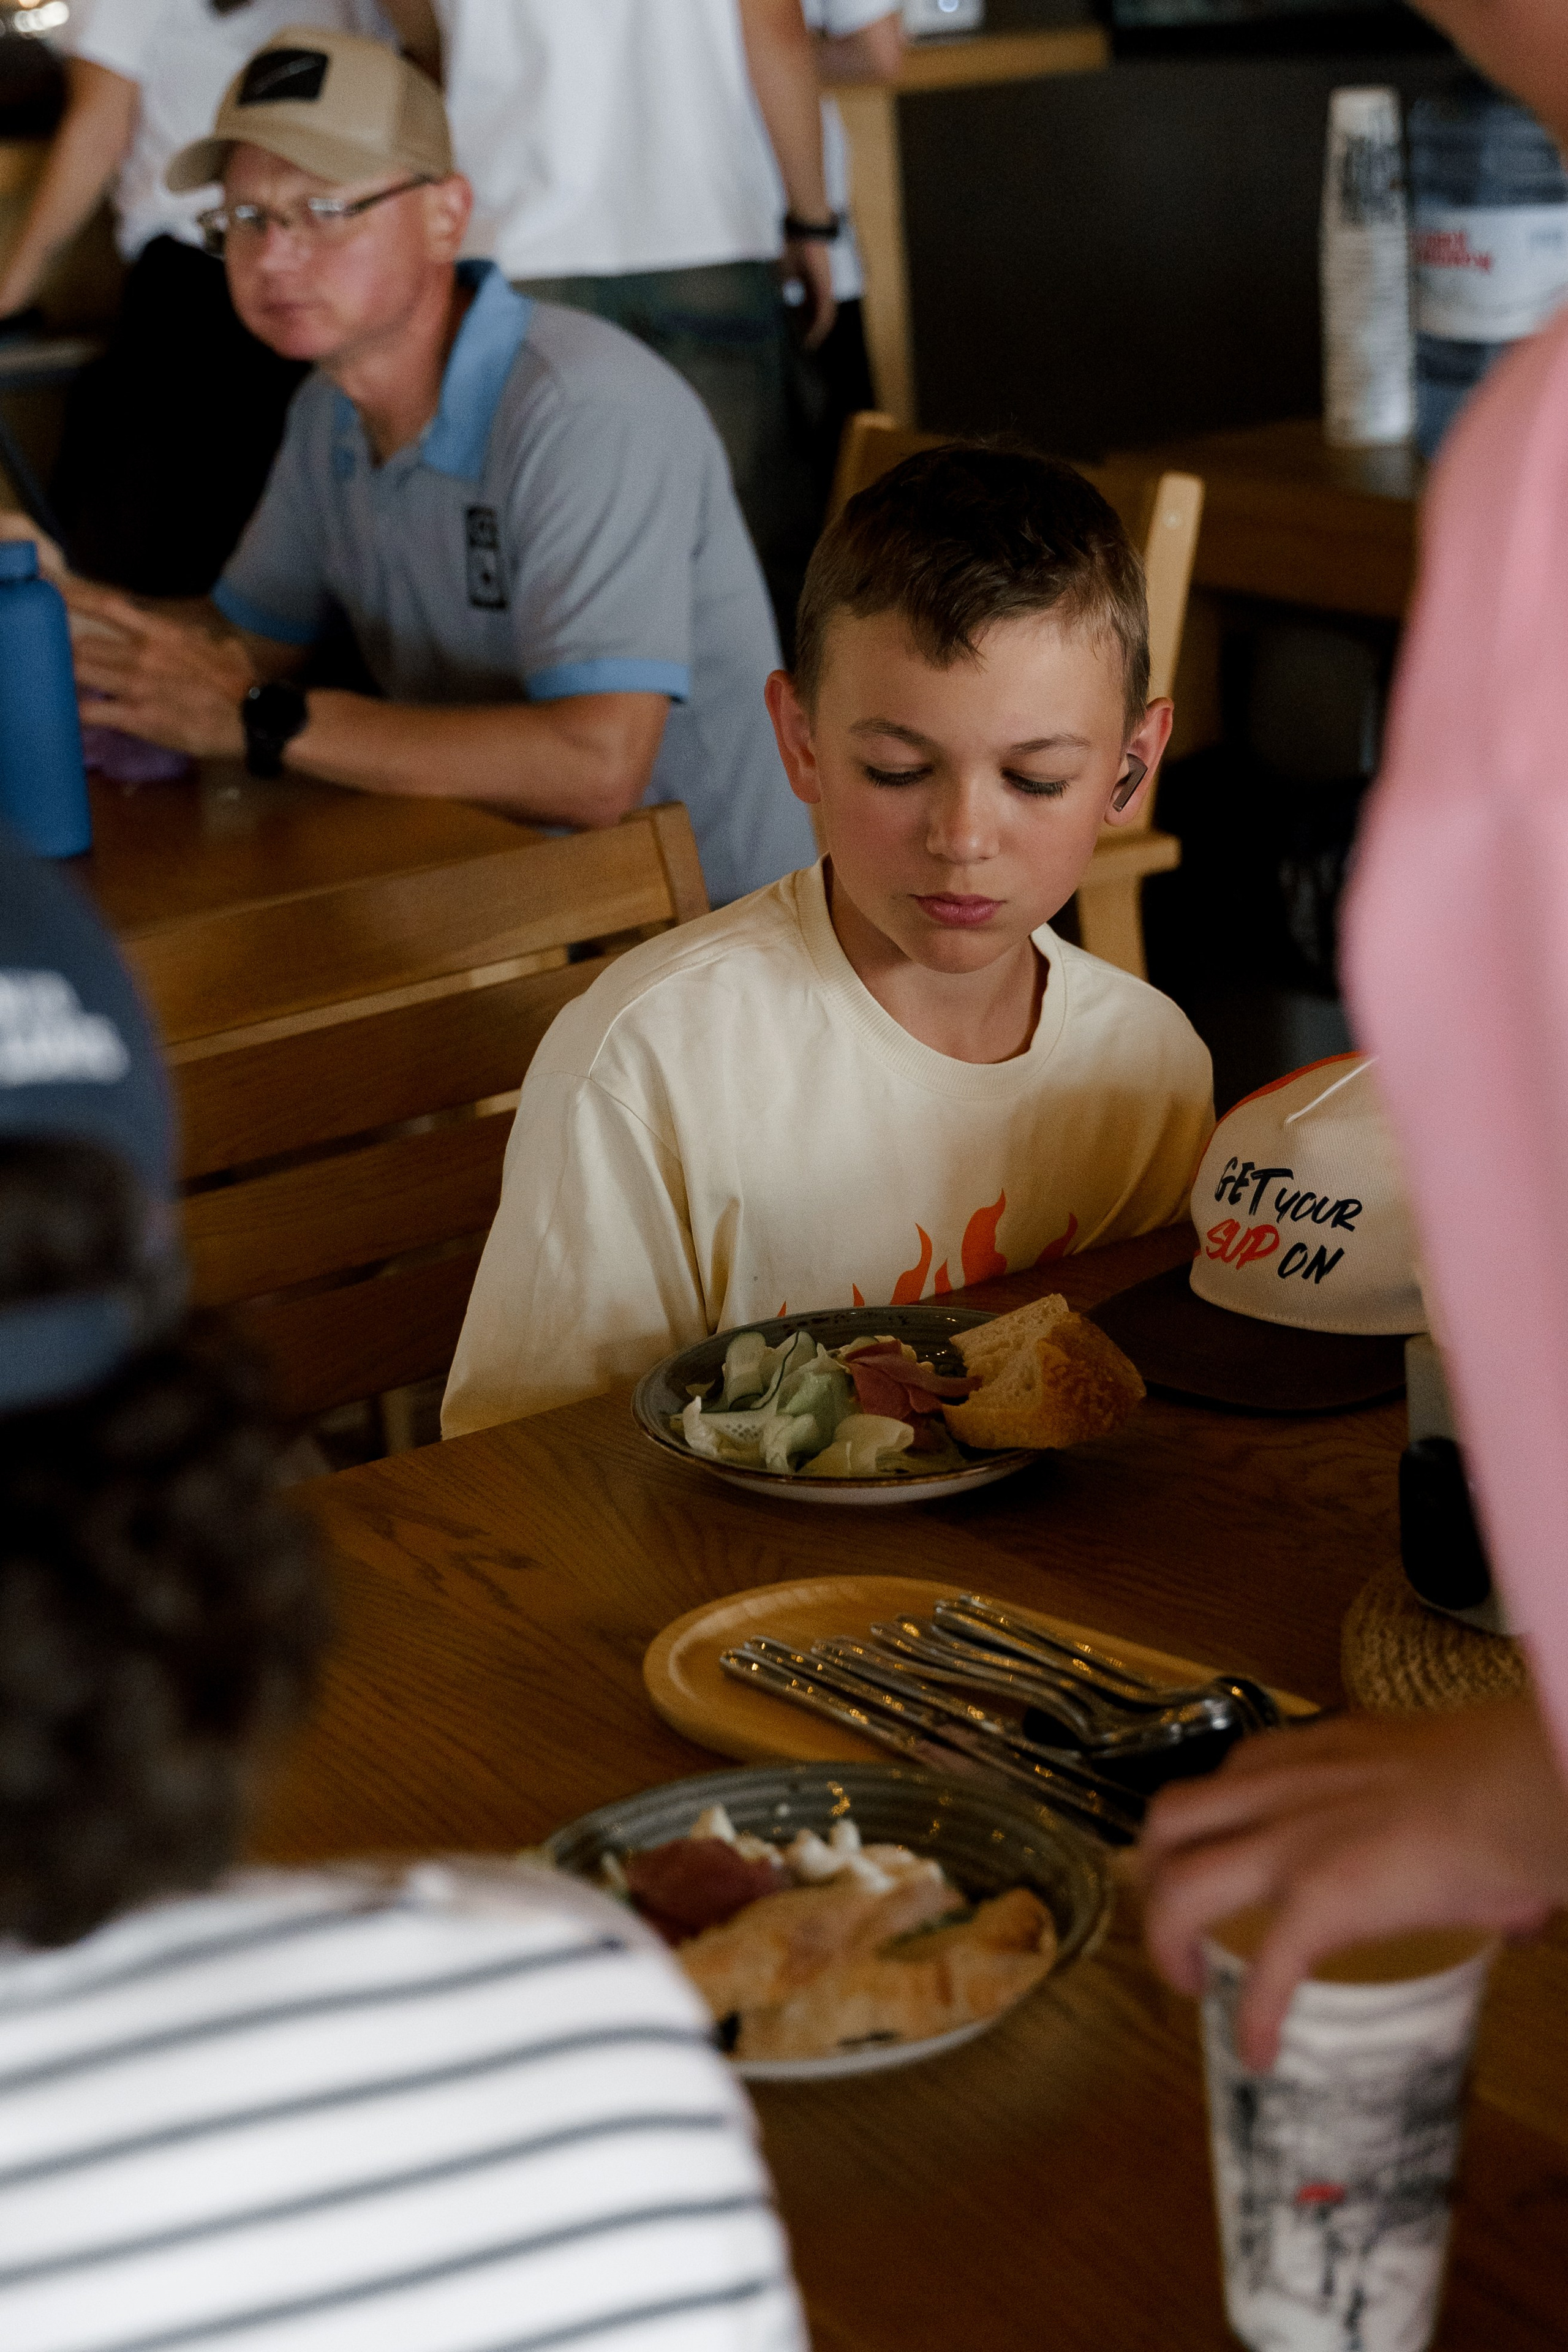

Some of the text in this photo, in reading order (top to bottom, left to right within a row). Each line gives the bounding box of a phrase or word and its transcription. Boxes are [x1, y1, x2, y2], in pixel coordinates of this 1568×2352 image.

[1214, 1156, 1363, 1232] GET YOUR
[1205, 1218, 1345, 1284] SUP ON
